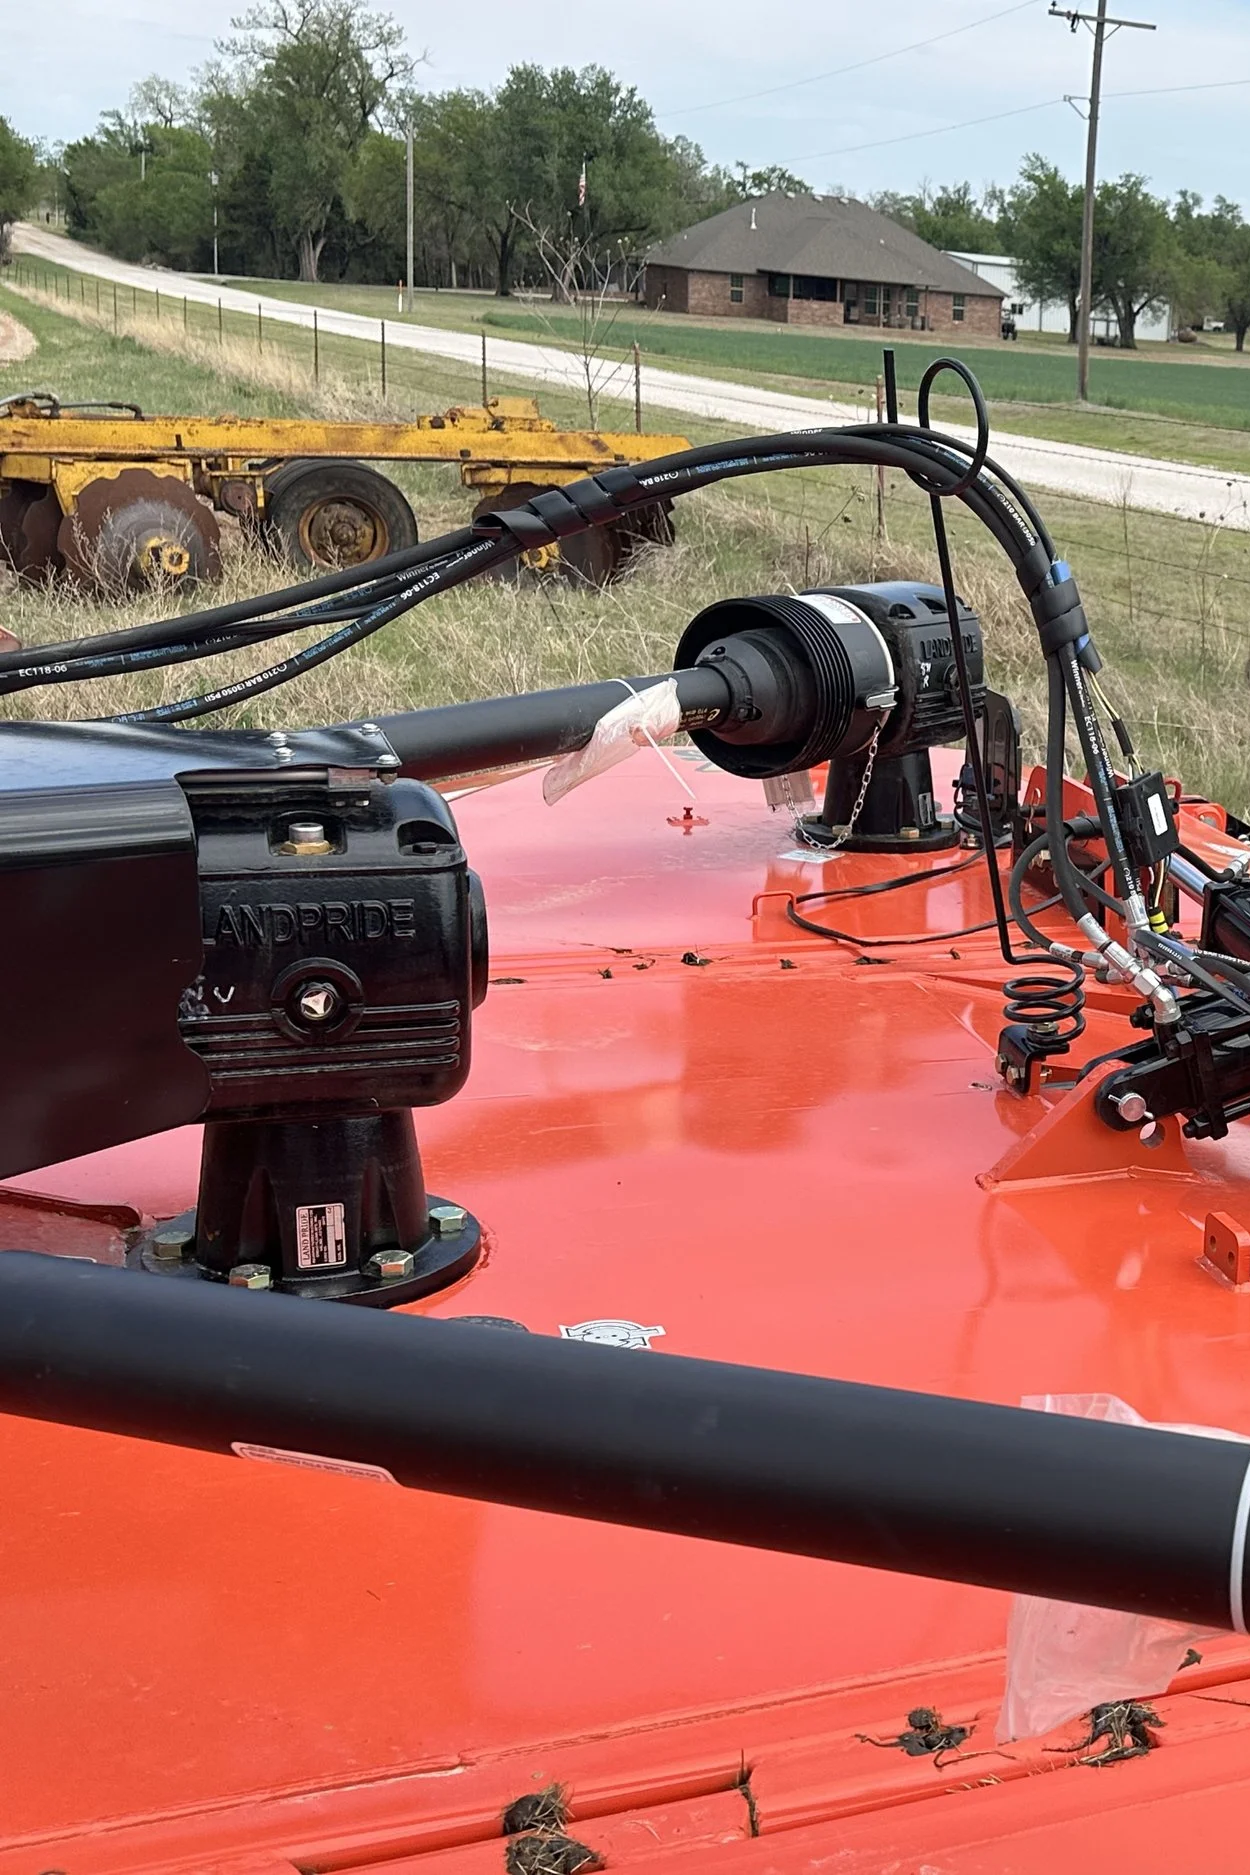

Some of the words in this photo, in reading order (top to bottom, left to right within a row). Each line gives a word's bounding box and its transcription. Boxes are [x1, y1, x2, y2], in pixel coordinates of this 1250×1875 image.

[1003, 499, 1015, 514] 210
[1012, 511, 1026, 529] BAR
[463, 540, 496, 561] Winner
[396, 566, 430, 582] Winner
[400, 571, 441, 601] EC118-06
[18, 664, 68, 678] EC118-06
[245, 675, 264, 688] BAR
[262, 669, 280, 681] 210
[1070, 659, 1084, 690] Winner
[1084, 715, 1100, 755] EC118-06
[1101, 747, 1115, 779] Winner
[201, 898, 418, 947] LANDPRIDE
[300, 1213, 309, 1238] PRIDE
[302, 1239, 311, 1261] LAND
